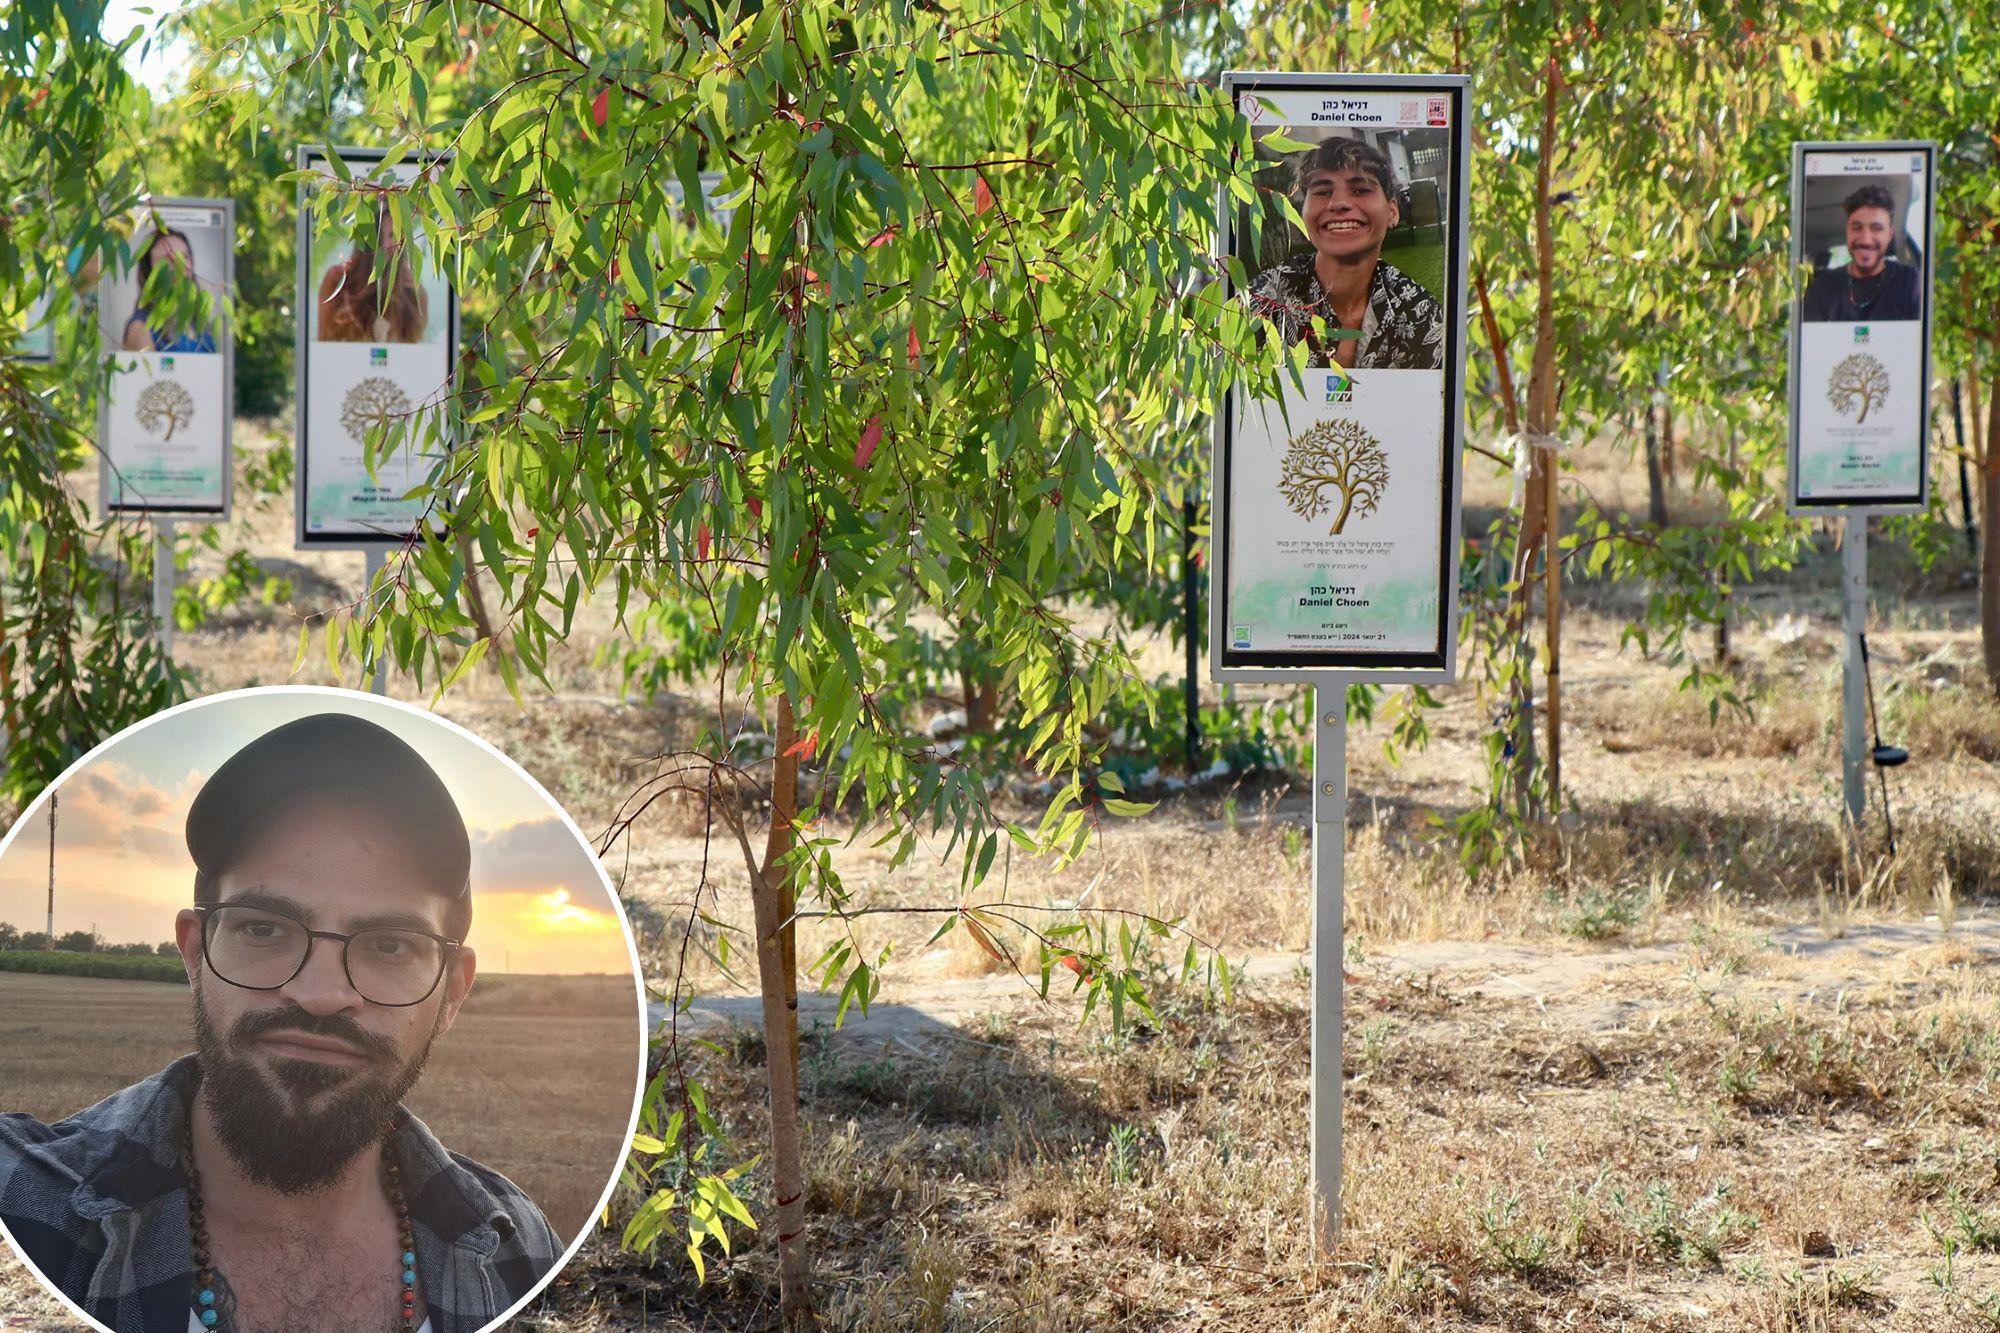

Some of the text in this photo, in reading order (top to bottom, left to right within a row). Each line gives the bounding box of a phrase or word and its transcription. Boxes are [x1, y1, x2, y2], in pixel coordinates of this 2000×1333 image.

[1322, 99, 1369, 110] דניאל כהן
[1311, 112, 1382, 122] Daniel Choen
[1310, 584, 1356, 596] דניאל כהן
[1299, 598, 1370, 607] Daniel Choen
